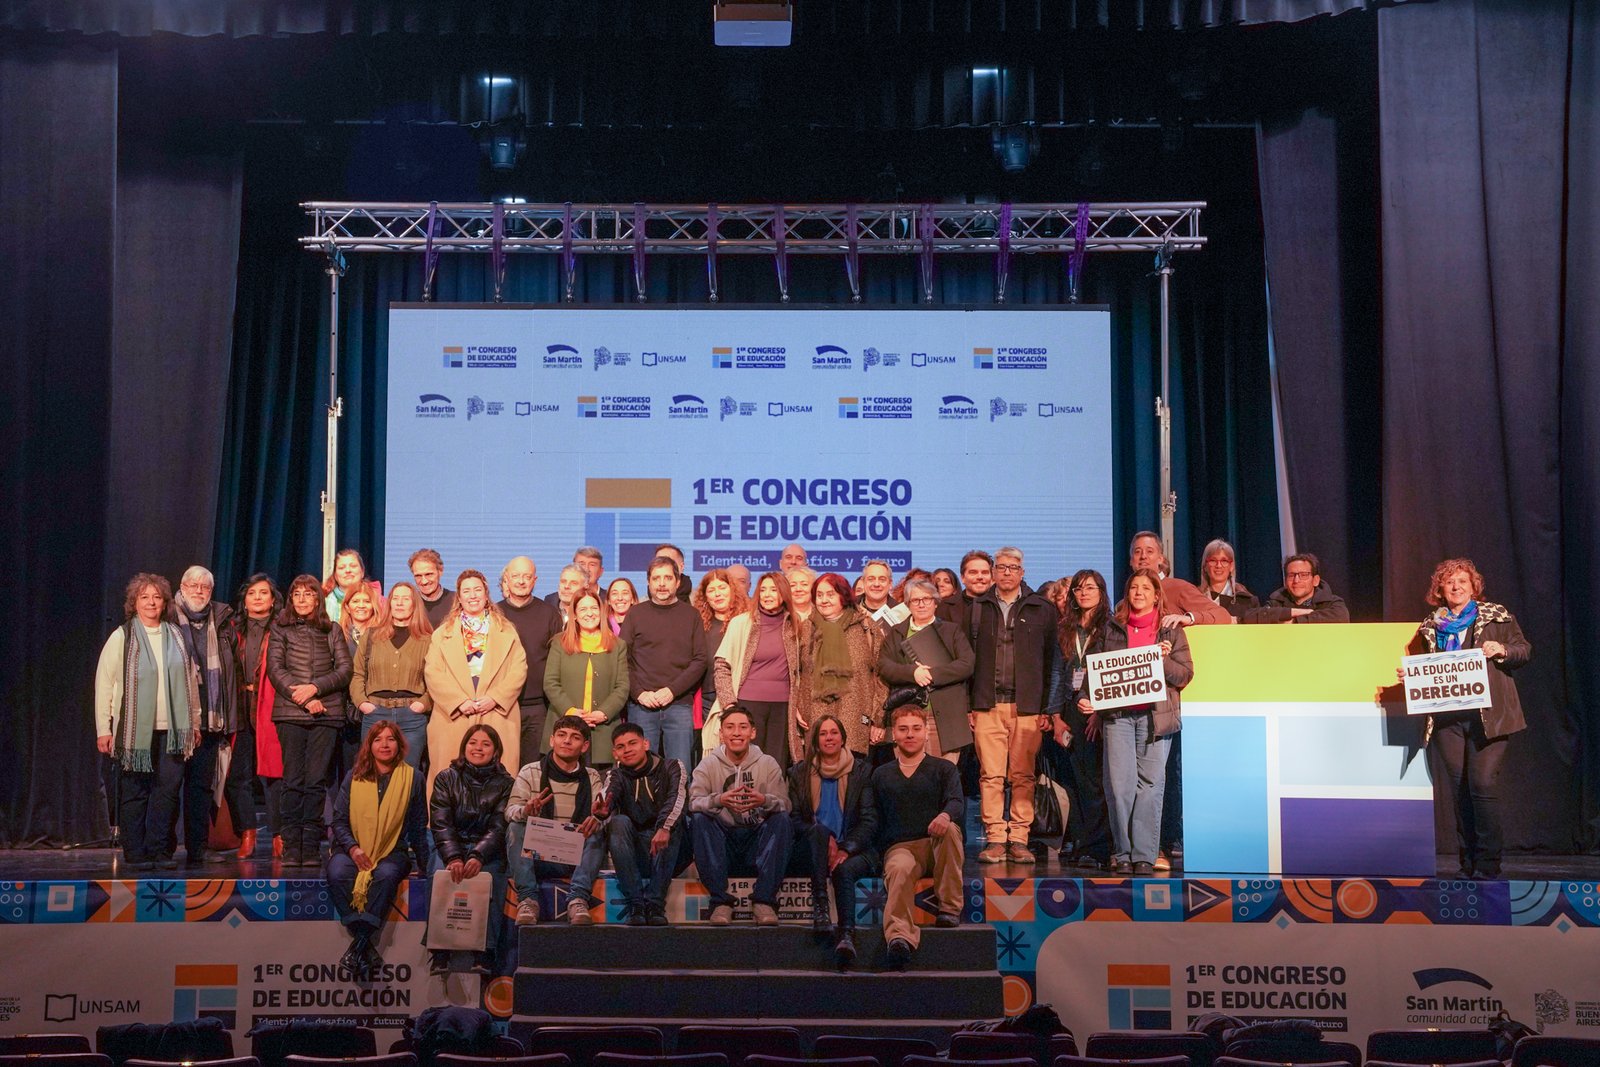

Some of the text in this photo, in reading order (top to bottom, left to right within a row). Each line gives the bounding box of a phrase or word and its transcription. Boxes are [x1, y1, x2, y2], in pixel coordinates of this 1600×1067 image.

[693, 478, 912, 506] 1ER CONGRESO
[693, 511, 911, 541] DE EDUCACIÓN
[846, 558, 854, 568] y
[1092, 651, 1159, 670] LA EDUCACIÓN
[1407, 659, 1482, 677] LA EDUCACIÓN
[1102, 666, 1150, 685] NO ES UN
[1434, 674, 1458, 684] ES UN
[1094, 680, 1162, 701] SERVICIO
[1410, 682, 1484, 700] DERECHO
[731, 882, 748, 893] 1ER
[254, 964, 283, 983] 1ER
[1186, 965, 1346, 985] 1ER CONGRESO
[253, 986, 411, 1008] DE EDUCACIÓN
[1187, 989, 1347, 1010] DE EDUCACIÓN
[1406, 996, 1502, 1011] San Martín
[0, 1006, 20, 1014] ENOS
[80, 1000, 140, 1013] UNSAM
[1406, 1014, 1466, 1024] comunidad
